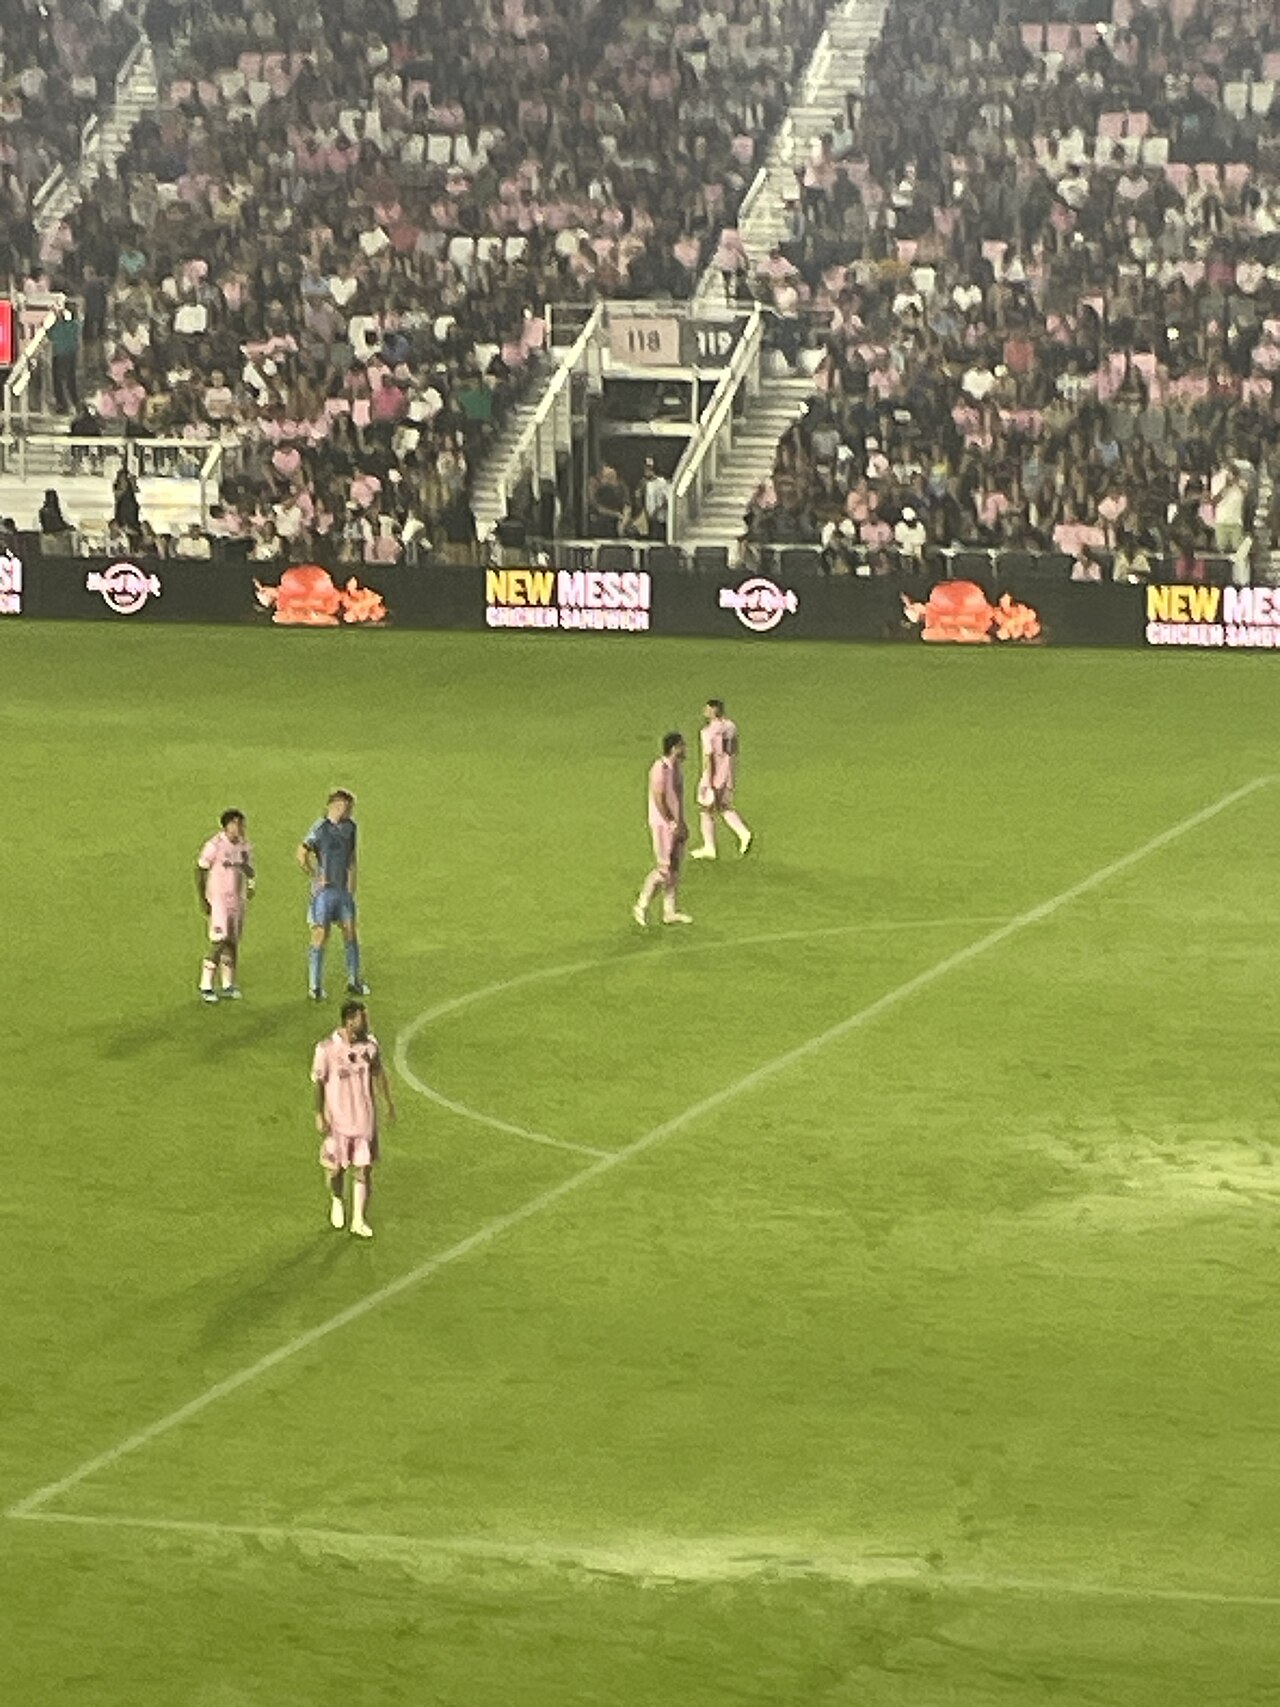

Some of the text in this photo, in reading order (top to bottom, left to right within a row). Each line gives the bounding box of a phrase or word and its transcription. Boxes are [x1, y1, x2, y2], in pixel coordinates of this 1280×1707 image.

[628, 329, 661, 352] 118
[486, 569, 650, 608] NEW MESSI
[1147, 585, 1220, 622] NEW
